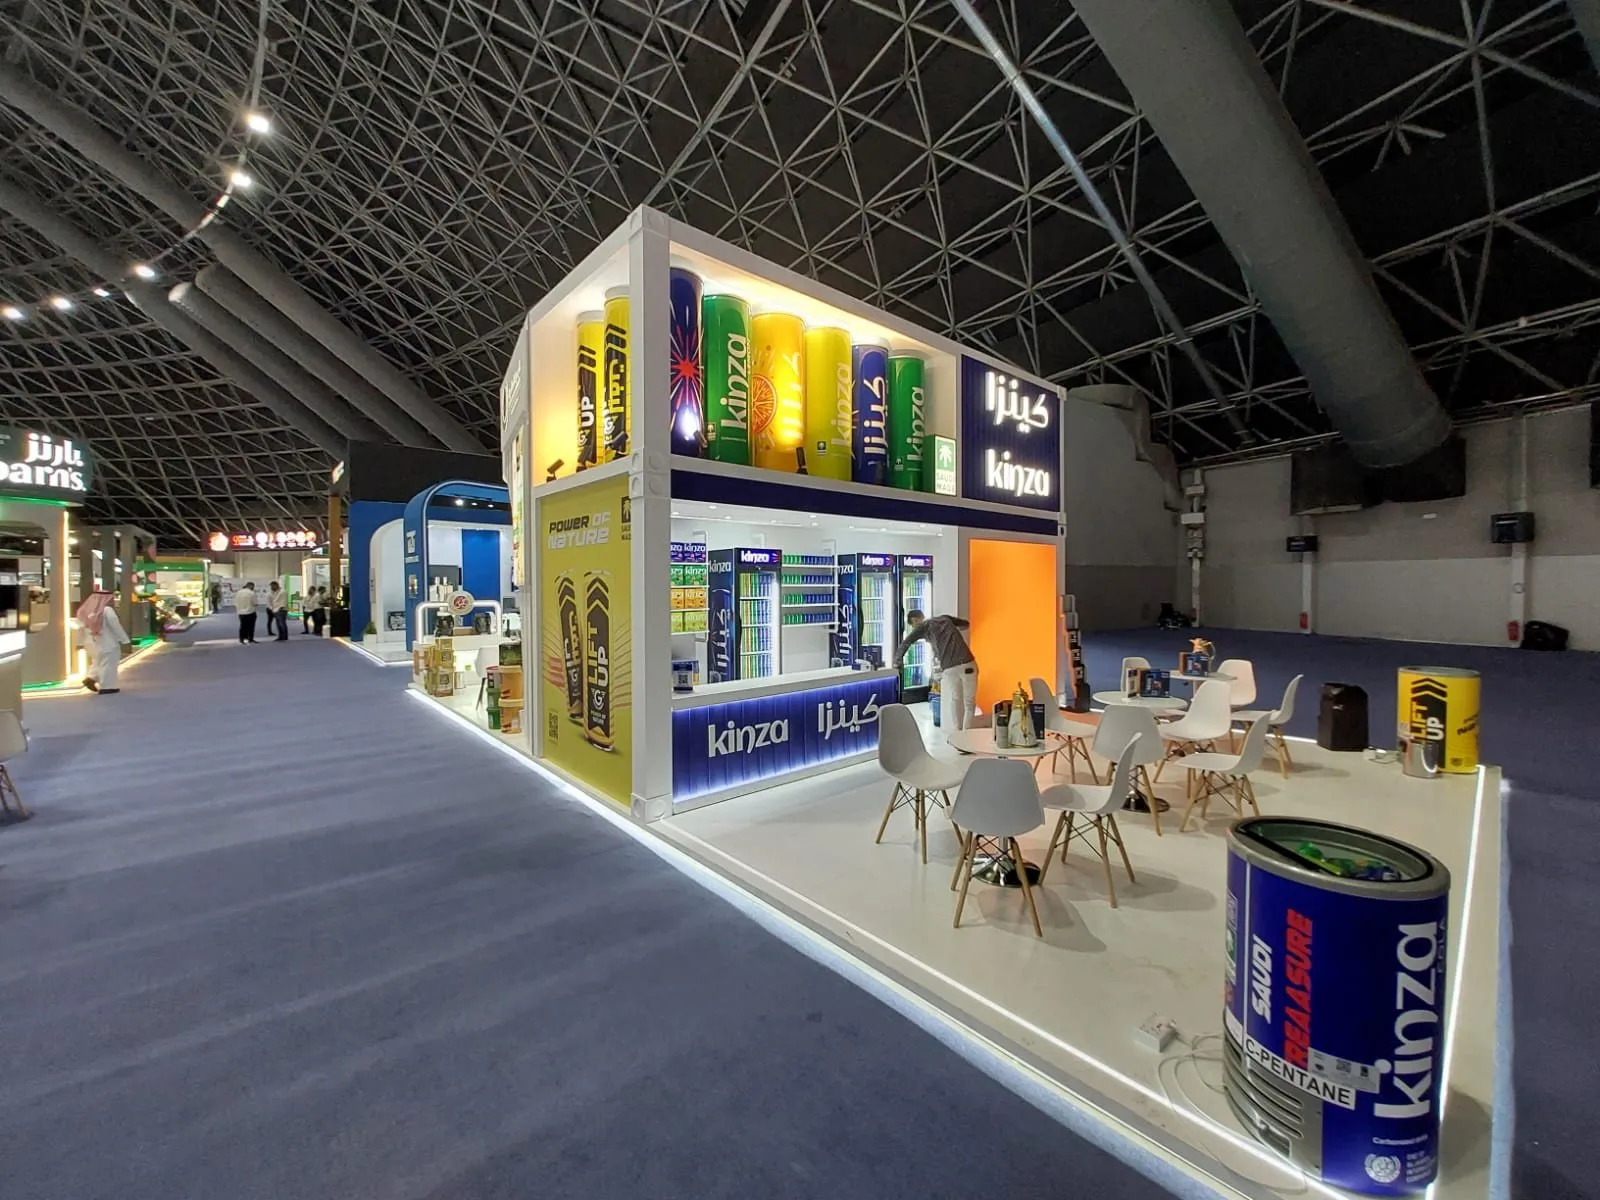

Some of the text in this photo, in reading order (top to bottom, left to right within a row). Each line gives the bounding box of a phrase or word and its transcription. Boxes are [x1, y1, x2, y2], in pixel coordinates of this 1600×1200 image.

[719, 332, 749, 430] kinza
[831, 362, 851, 448] kinza
[985, 371, 1050, 434] كينزا
[580, 395, 595, 428] UP
[863, 375, 889, 456] كينزا
[906, 386, 926, 461] kinza
[985, 448, 1051, 498] kinza
[549, 511, 612, 535] POWER OF
[684, 543, 706, 553] kinza
[741, 549, 770, 564] kinza
[587, 621, 598, 685] LIFT
[597, 645, 609, 687] UP
[708, 718, 789, 758] kinza
[817, 693, 881, 740] كينزا
[1426, 716, 1444, 741] UP
[1251, 933, 1273, 1025] SAUDI
[1373, 920, 1439, 1119] kinza
[1244, 1038, 1351, 1106] C-PENTANE
